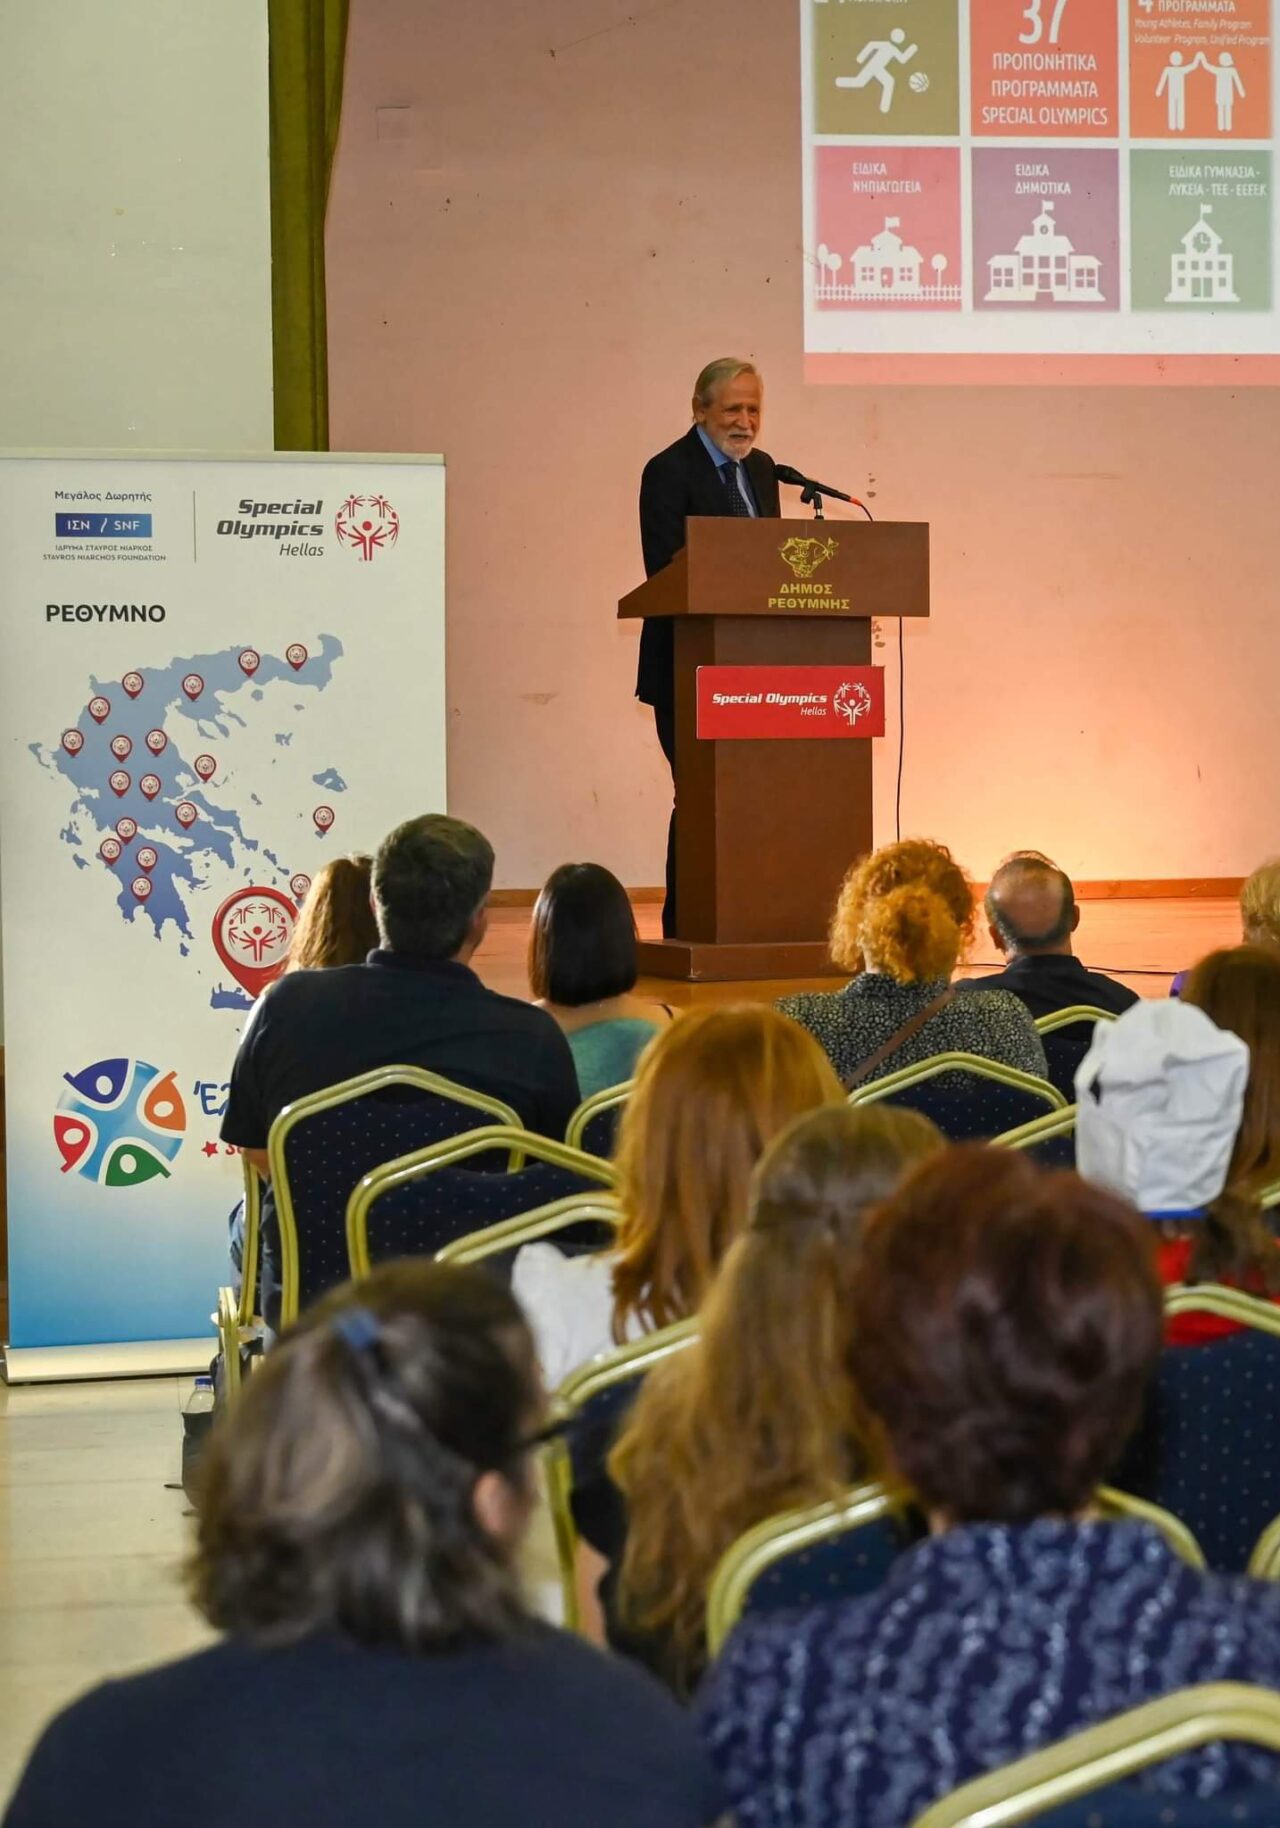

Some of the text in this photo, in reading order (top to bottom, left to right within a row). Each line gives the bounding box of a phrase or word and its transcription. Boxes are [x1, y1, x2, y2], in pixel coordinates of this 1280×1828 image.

[992, 52, 1097, 71] ΠΡΟΠΟΝΗΤΙΚΑ
[991, 79, 1099, 98] ΠΡΟΓΡΑΜΜΑΤΑ
[982, 106, 1108, 126] SPECIAL OLYMPICS
[853, 162, 887, 176] ΕΙΔΙΚΑ
[1015, 164, 1050, 177] ΕΙΔΙΚΑ
[1169, 165, 1202, 178] ΕΙΔΙΚΑ
[853, 180, 922, 194] ΝΗΠΙΑΓΩΓΕΙΑ
[1015, 181, 1071, 195] ΔΗΜΟΤΙΚΑ
[1169, 183, 1204, 196] ΛΥΚΕΙΑ
[1211, 183, 1229, 197] ΤΕΕ
[55, 490, 152, 502] Μεγάλος Δωρητής
[238, 499, 323, 518] Special
[114, 520, 140, 531] SNF
[216, 519, 324, 538] Olympics
[279, 542, 324, 558] Hellas
[779, 583, 833, 595] ΔΗΜΟΣ
[768, 597, 850, 610] ΡΕΘΥΜΝΗΣ
[45, 604, 166, 623] ΡΕΘΥΜΝΟ
[712, 692, 827, 706] Special Olympics
[800, 705, 827, 716] Hellas
